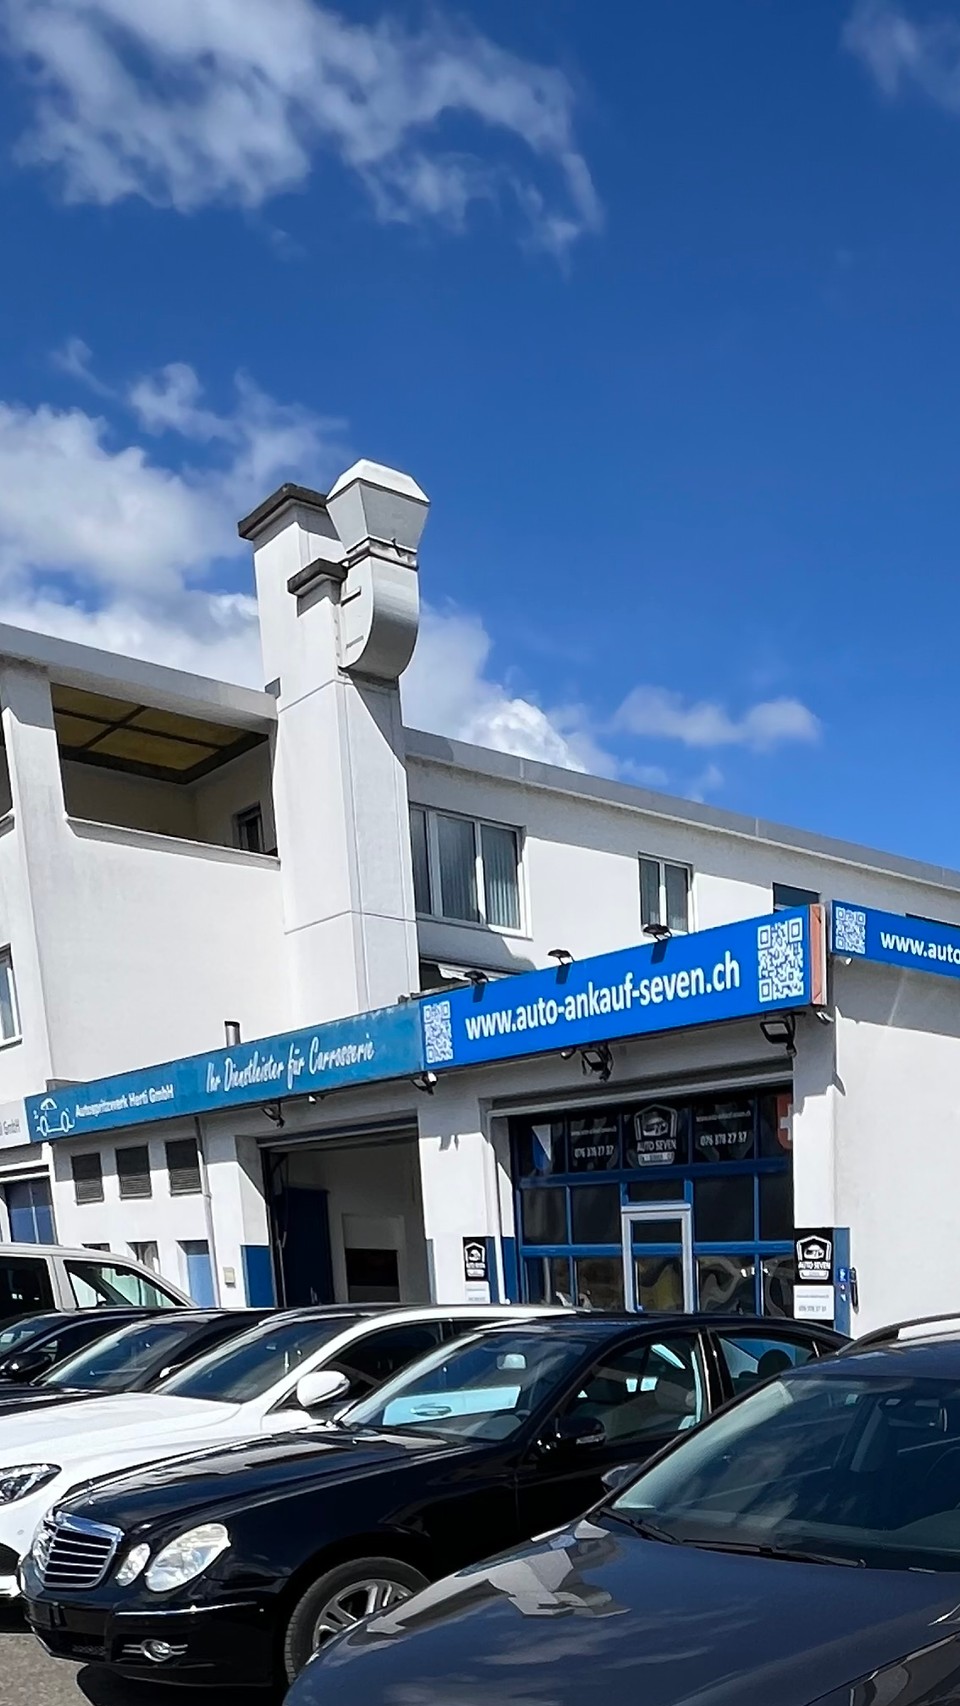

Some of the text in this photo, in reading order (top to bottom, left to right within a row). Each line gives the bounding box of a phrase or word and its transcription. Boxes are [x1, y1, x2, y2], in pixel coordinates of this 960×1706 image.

[466, 949, 741, 1041] www.auto-ankauf-seven.ch
[206, 1033, 375, 1093] Ihr Dienstleister für Carrosserie
[148, 1083, 174, 1104] GmbH
